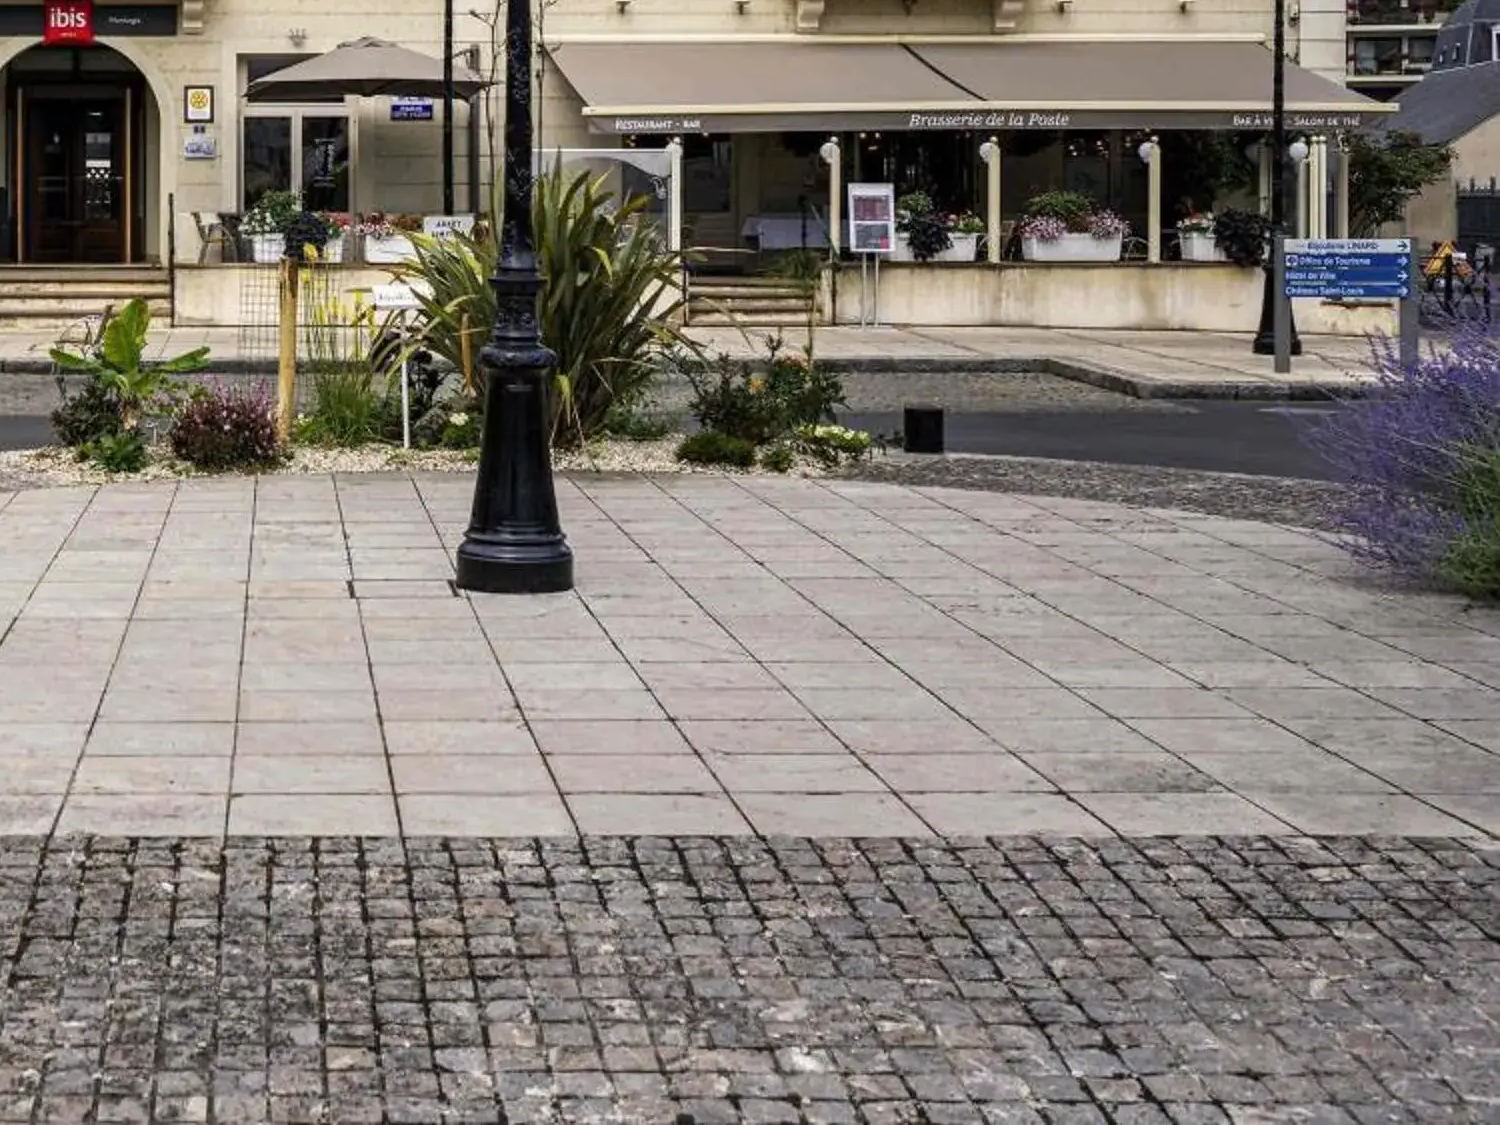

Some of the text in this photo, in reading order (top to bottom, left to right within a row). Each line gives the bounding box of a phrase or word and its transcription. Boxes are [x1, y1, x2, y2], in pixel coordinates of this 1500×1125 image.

[50, 7, 87, 28] ibis
[909, 113, 1069, 127] Brasserie de la Poste
